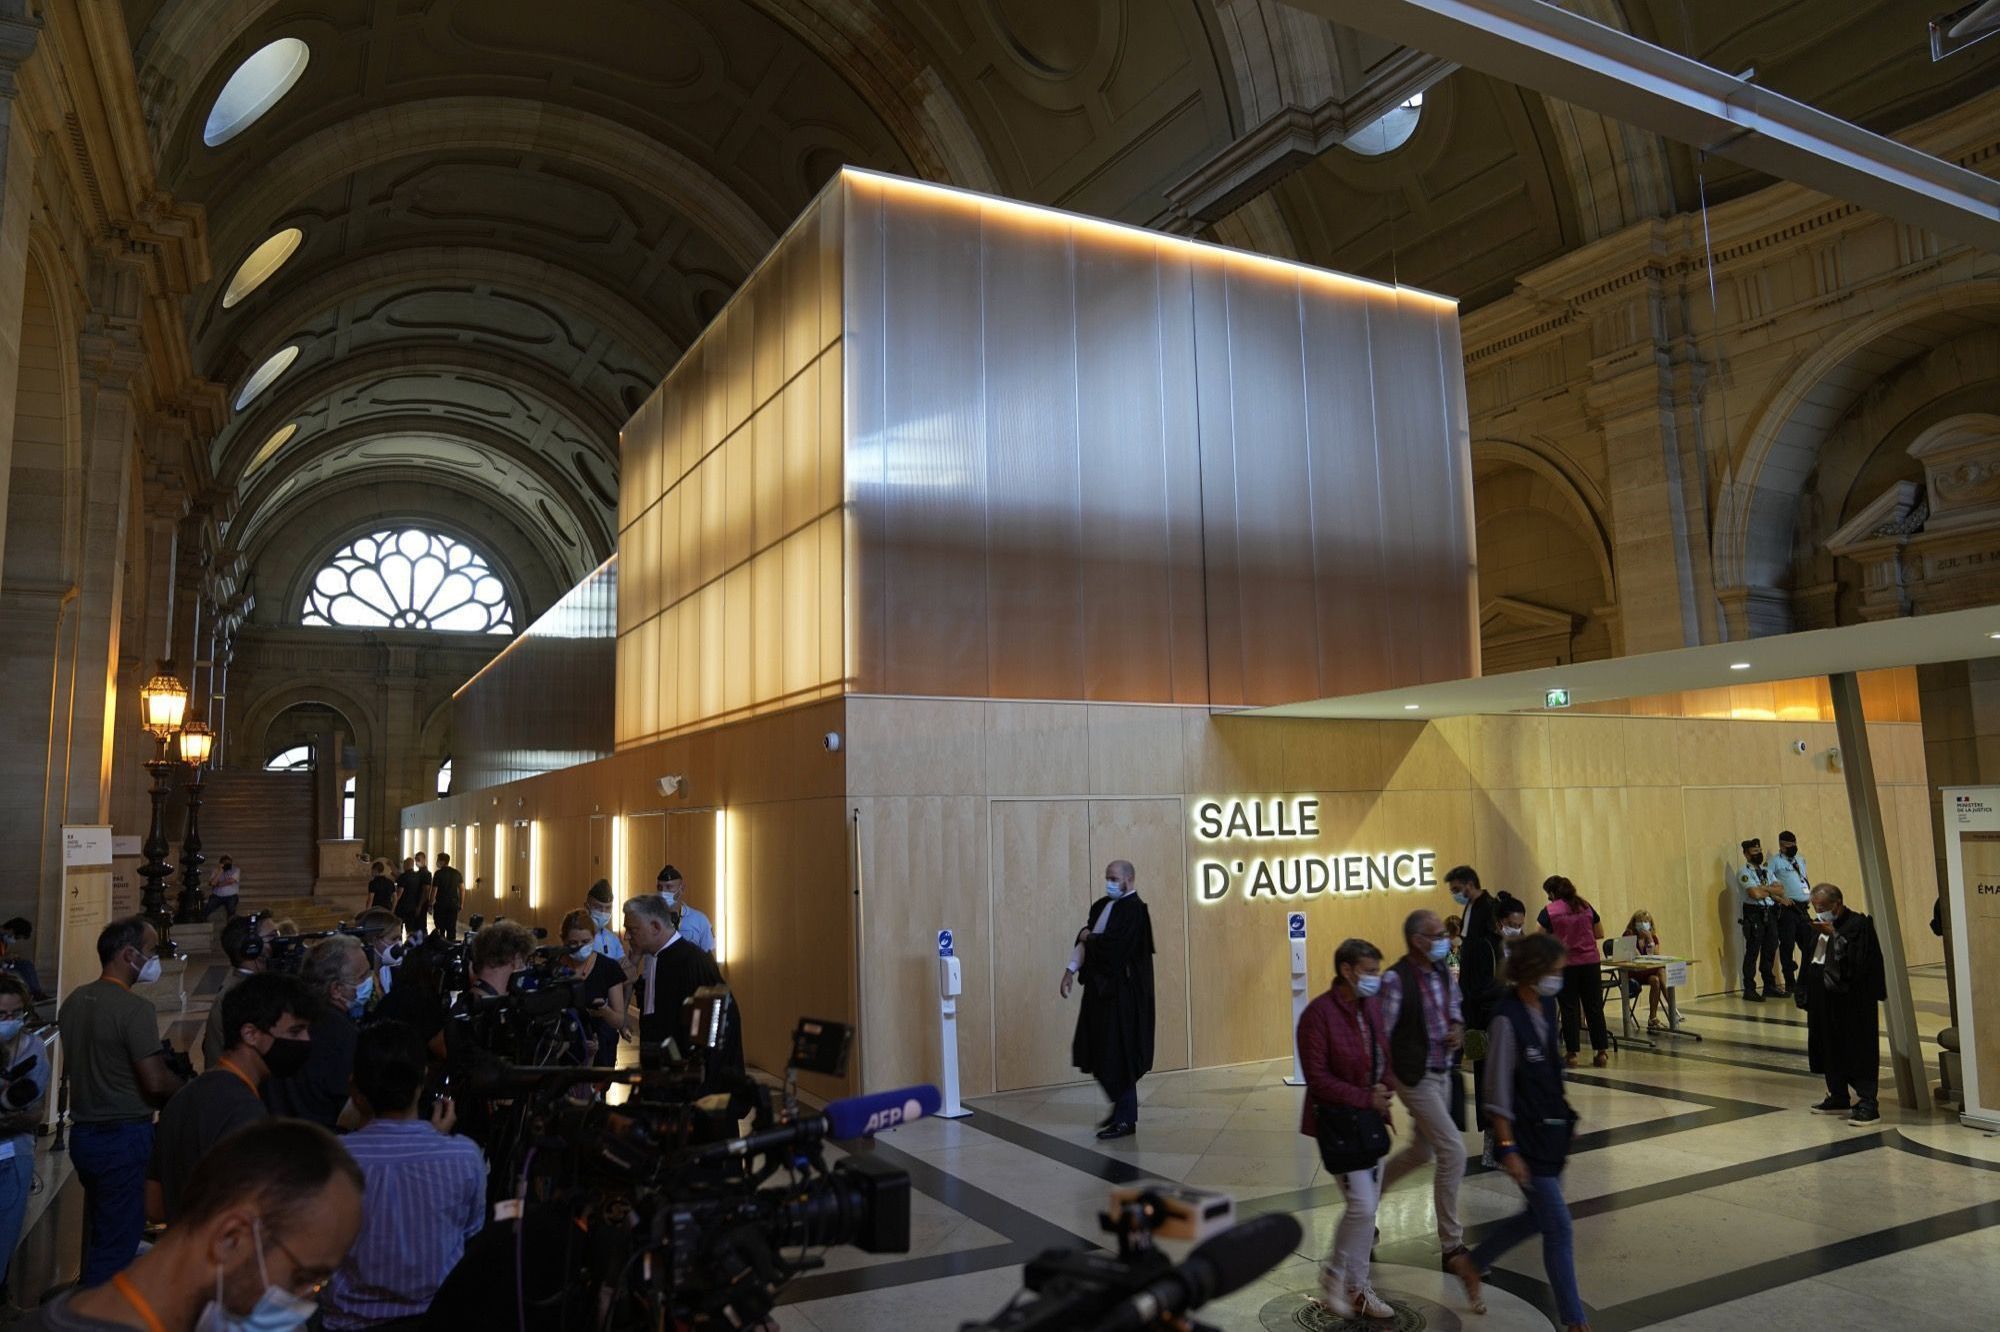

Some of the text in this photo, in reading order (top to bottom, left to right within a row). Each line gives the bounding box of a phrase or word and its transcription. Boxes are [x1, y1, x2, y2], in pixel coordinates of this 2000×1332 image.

[1200, 800, 1320, 839] SALLE
[1203, 852, 1438, 900] D'AUDIENCE
[863, 1106, 902, 1134] AFP
